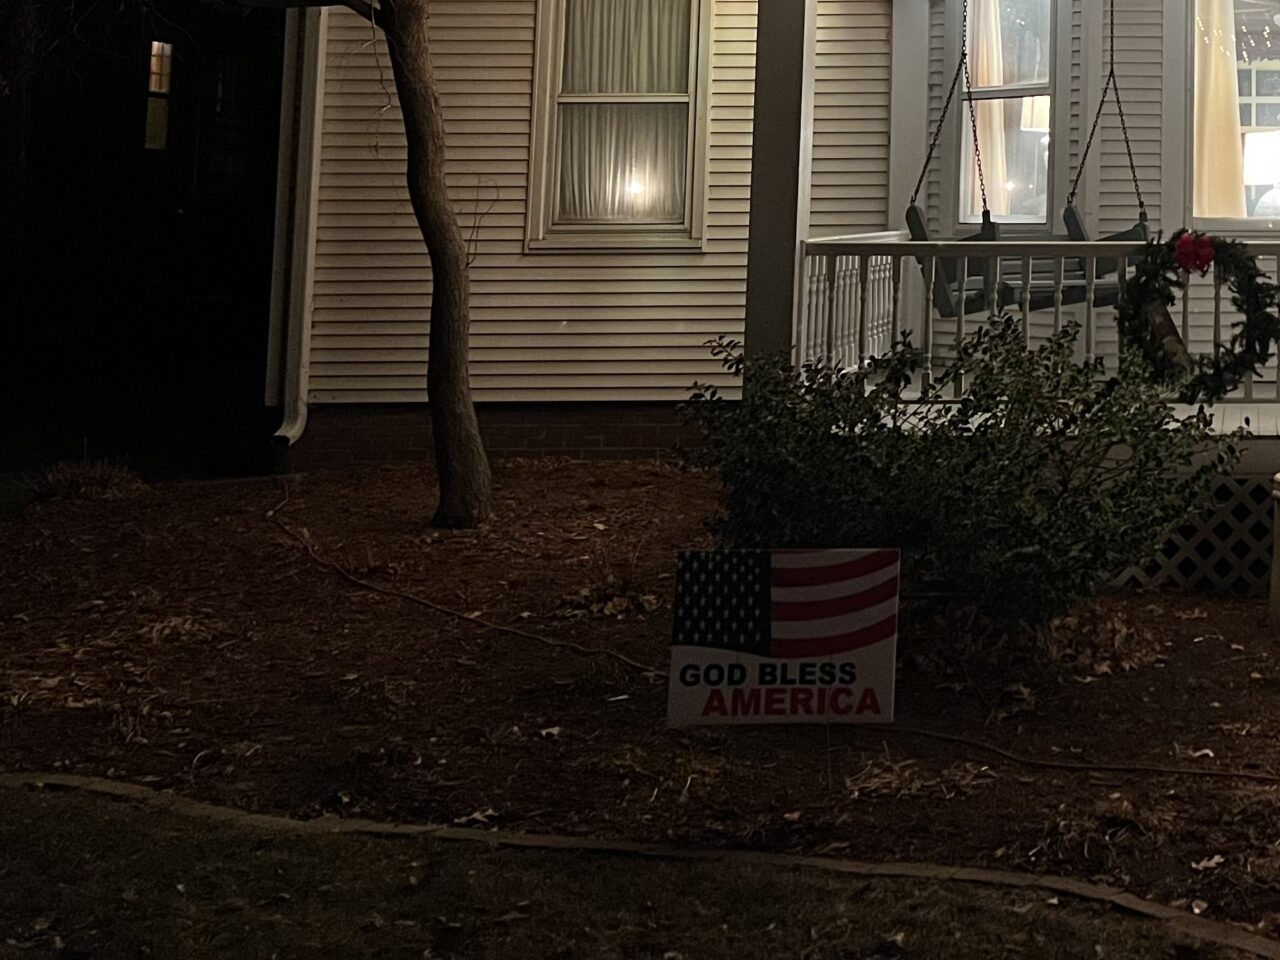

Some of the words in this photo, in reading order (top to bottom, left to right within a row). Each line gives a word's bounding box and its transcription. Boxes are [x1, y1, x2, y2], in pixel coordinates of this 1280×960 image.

[680, 663, 747, 686] GOD
[758, 662, 856, 685] BLESS
[702, 687, 881, 716] AMERICA
